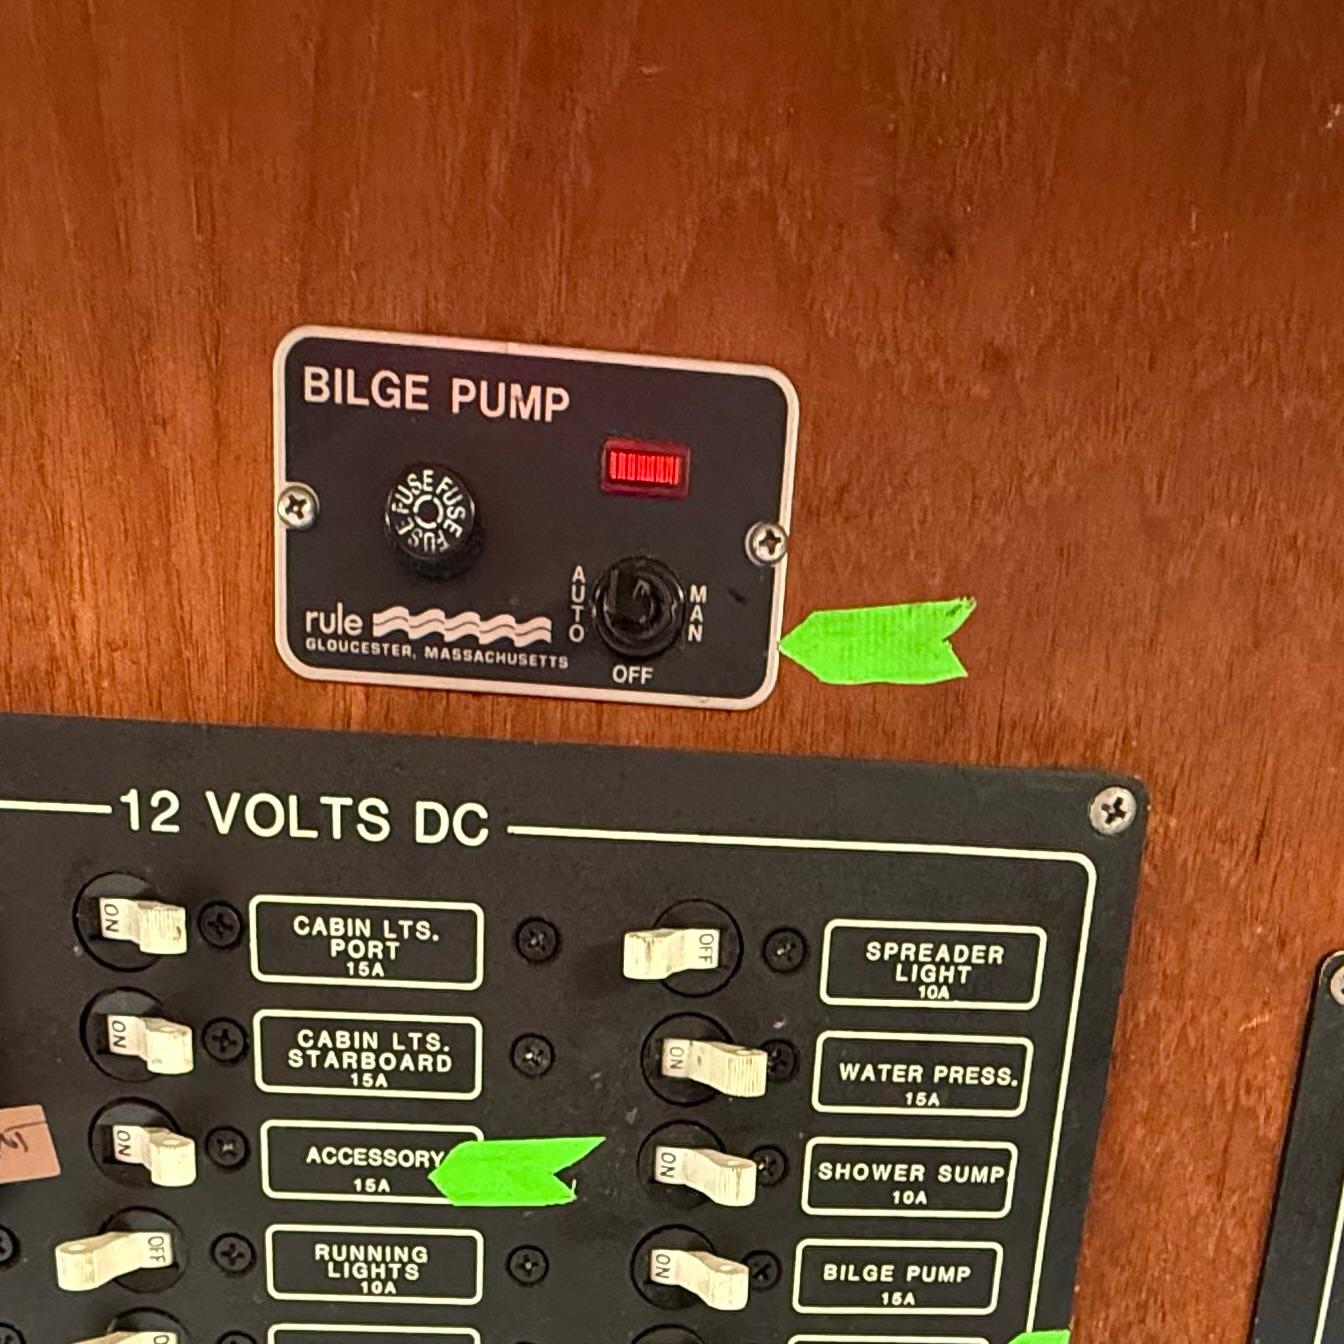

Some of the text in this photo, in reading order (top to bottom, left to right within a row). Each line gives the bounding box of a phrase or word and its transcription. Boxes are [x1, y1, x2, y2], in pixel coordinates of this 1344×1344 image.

[304, 366, 570, 422] BILGE PUMP
[391, 469, 434, 514] FUSE
[435, 476, 466, 538] FUSE
[395, 516, 450, 552] FUSE
[569, 565, 586, 643] AUTO
[688, 584, 707, 642] MAN
[306, 602, 363, 635] rule
[305, 637, 569, 669] GLOUCESTER, MASSACHUSETTS
[612, 664, 654, 685] OFF
[121, 789, 489, 847] 12 VOLTS DC
[104, 903, 119, 932] ON
[293, 915, 439, 942] CABIN LTS.
[330, 940, 399, 960] PORT
[698, 933, 715, 965] OFF
[866, 941, 1004, 965] SPREADER
[346, 962, 385, 977] 15A
[895, 963, 972, 984] LIGHT
[918, 985, 950, 1000] 10A
[112, 1020, 128, 1049] ON
[297, 1029, 450, 1053] CABIN LTS.
[288, 1050, 452, 1073] STARBOARD
[669, 1046, 685, 1070] ON
[351, 1072, 387, 1088] 15A
[839, 1063, 1019, 1087] WATER PRESS.
[905, 1092, 940, 1107] 15A
[117, 1130, 131, 1157] ON
[306, 1146, 445, 1169] ACCESSORY
[660, 1151, 677, 1179] ON
[817, 1162, 1005, 1184] SHOWER SUMP
[353, 1178, 390, 1193] 15A
[892, 1190, 928, 1205] 10A
[147, 1235, 166, 1263] OFF
[314, 1244, 428, 1264] RUNNING
[327, 1263, 420, 1281] LIGHTS
[655, 1253, 671, 1279] ON
[823, 1264, 972, 1283] BILGE PUMP
[360, 1280, 397, 1295] 10A
[881, 1292, 915, 1306] 15A
